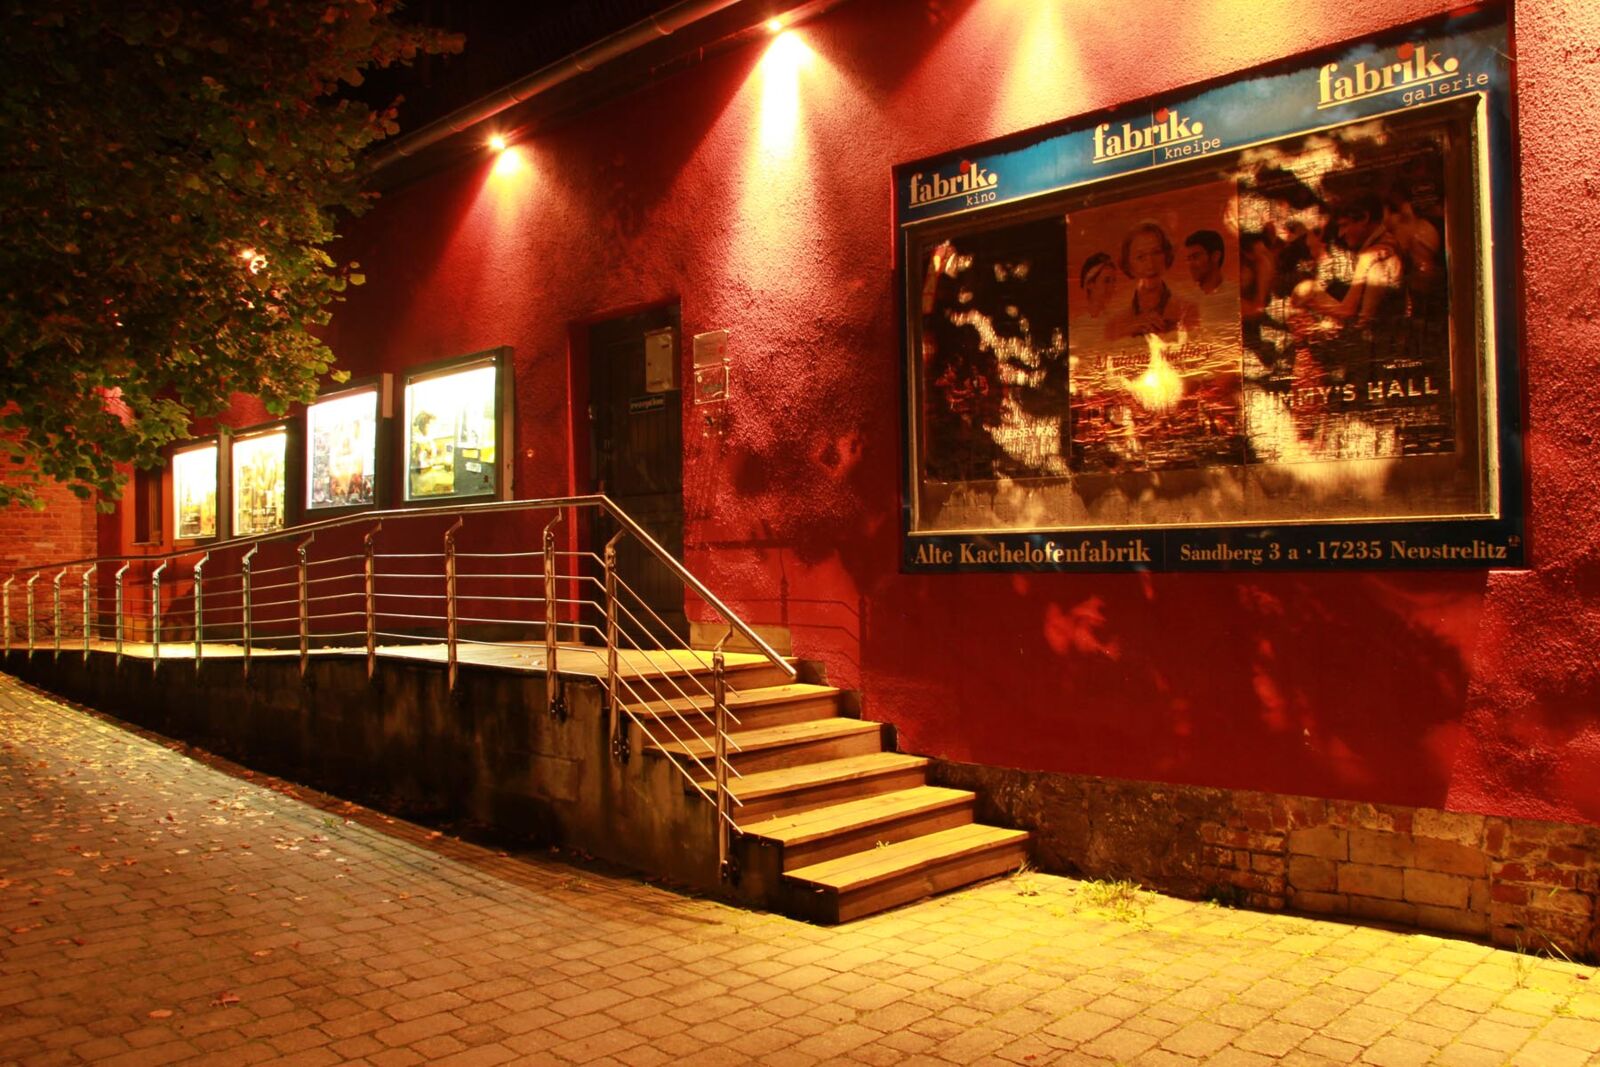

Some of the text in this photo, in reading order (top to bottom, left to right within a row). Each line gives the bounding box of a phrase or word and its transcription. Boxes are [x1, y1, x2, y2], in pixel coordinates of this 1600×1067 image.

[1402, 72, 1489, 106] galerie
[1164, 137, 1221, 160] kneipe
[966, 190, 997, 207] kino
[1367, 376, 1439, 401] HALL
[915, 543, 953, 565] Alte
[959, 539, 1151, 564] Kachelofenfabrik
[1180, 541, 1263, 566] Sandberg
[1269, 542, 1281, 560] 3
[1288, 546, 1299, 560] a
[1317, 540, 1383, 560] 17235
